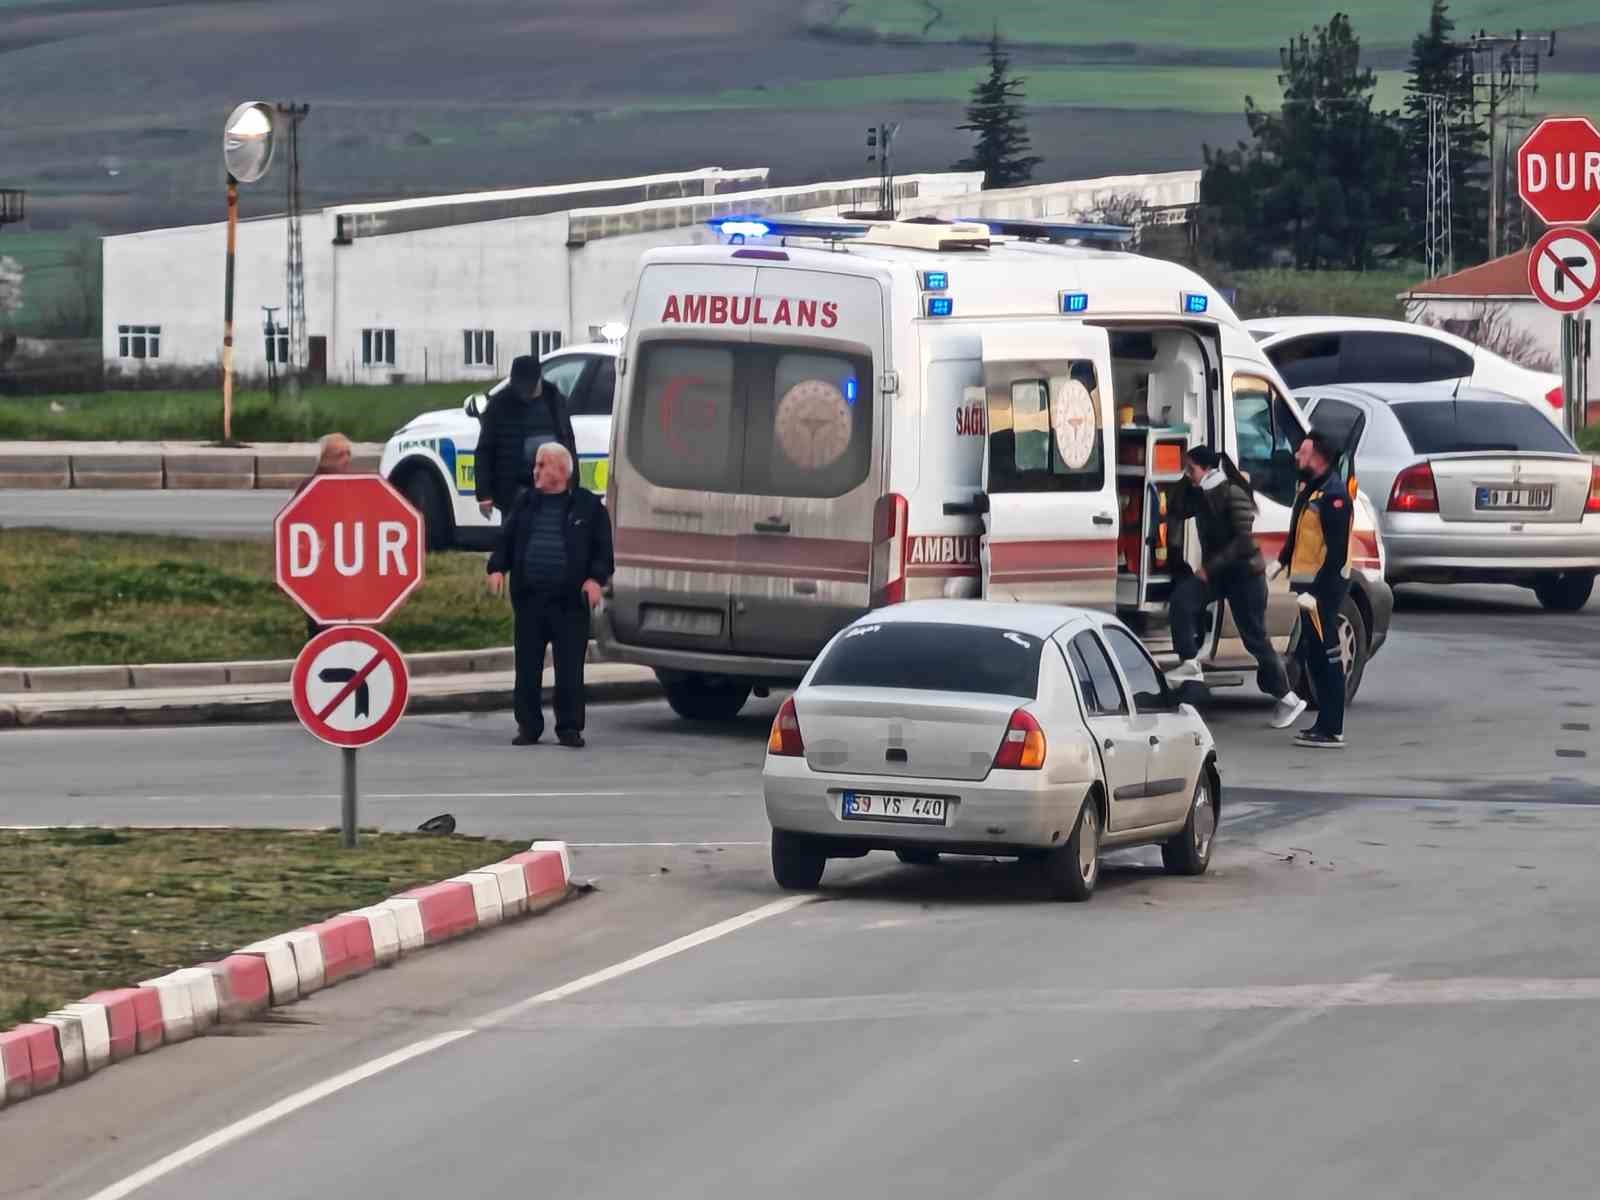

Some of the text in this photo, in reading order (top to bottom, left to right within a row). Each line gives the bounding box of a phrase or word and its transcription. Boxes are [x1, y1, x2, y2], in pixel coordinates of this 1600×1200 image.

[1527, 151, 1600, 193] DUR
[661, 294, 838, 328] AMBULANS
[289, 521, 408, 577] DUR
[912, 799, 941, 816] 440
